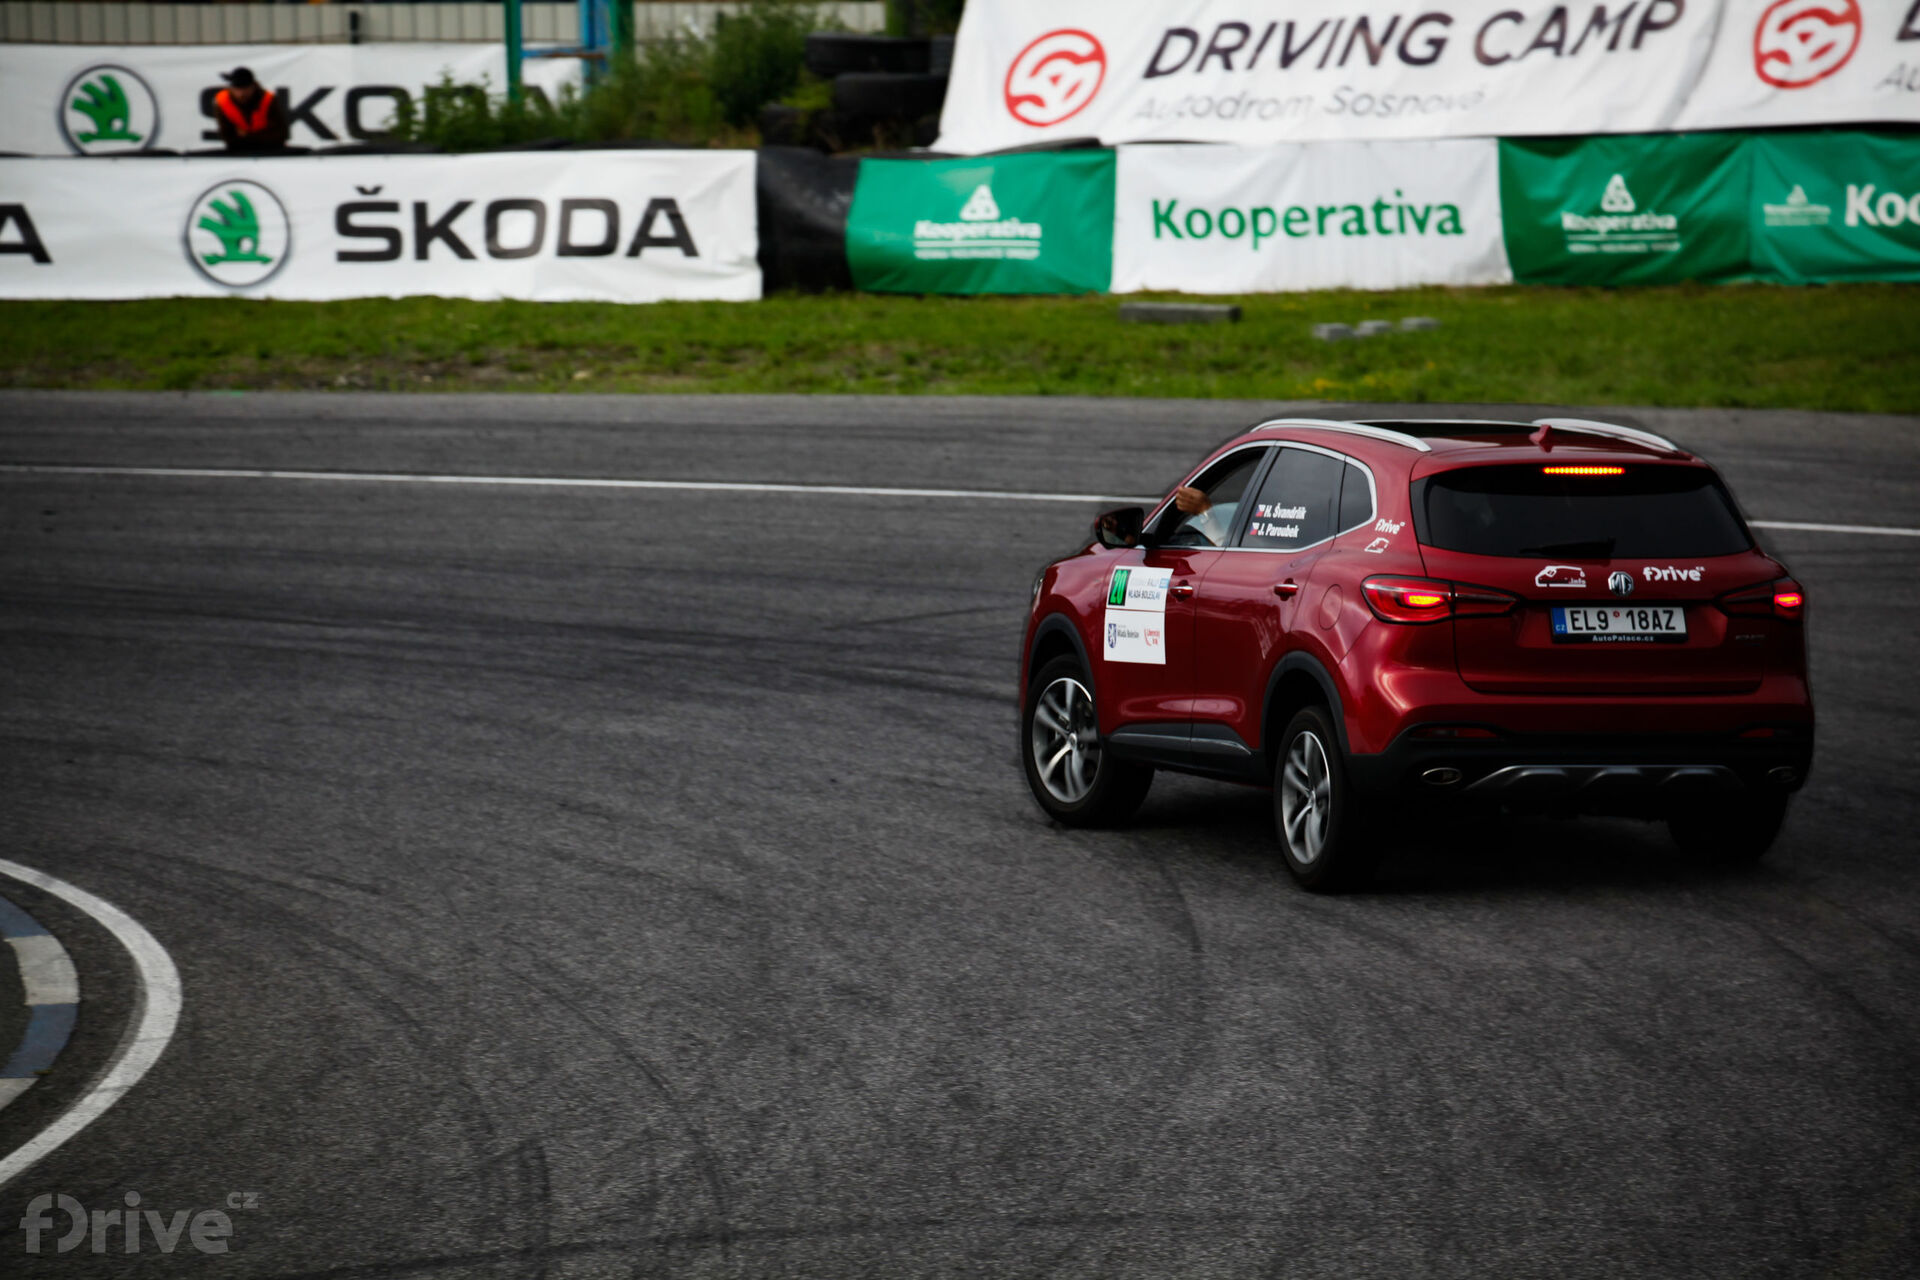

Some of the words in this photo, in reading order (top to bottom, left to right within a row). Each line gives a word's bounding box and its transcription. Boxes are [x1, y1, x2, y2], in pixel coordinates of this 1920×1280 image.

[1143, 13, 1454, 79] DRIVING
[1474, 0, 1686, 66] CAMP
[335, 184, 700, 263] ŠKODA
[1152, 188, 1466, 251] Kooperativa
[1570, 609, 1609, 631] EL9
[1626, 609, 1676, 631] 18AZ
